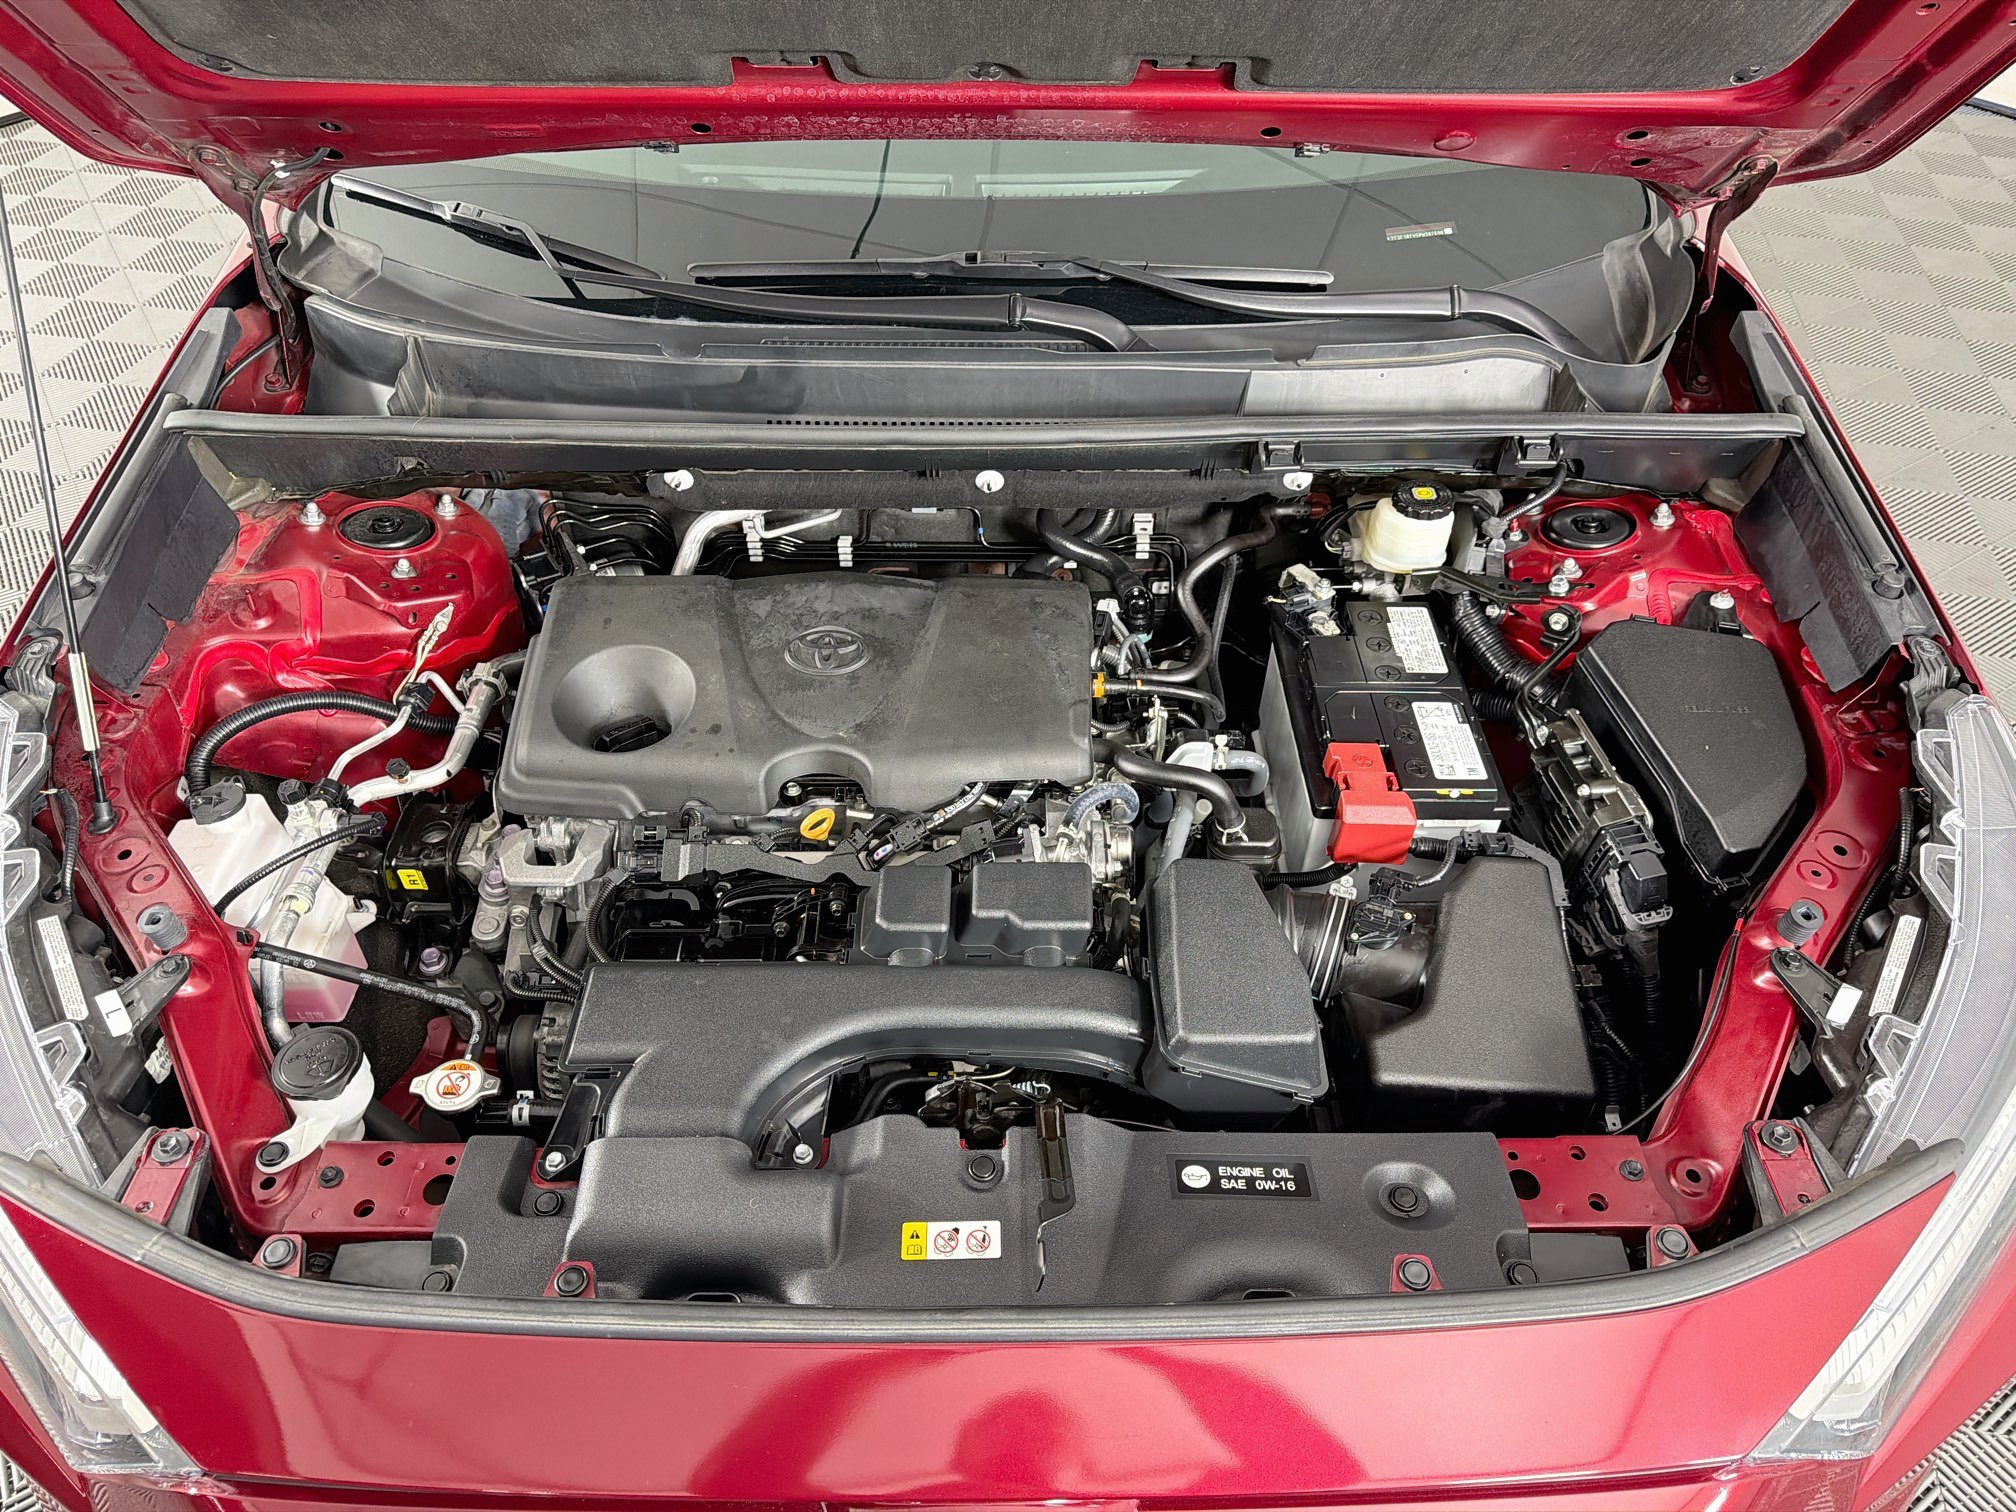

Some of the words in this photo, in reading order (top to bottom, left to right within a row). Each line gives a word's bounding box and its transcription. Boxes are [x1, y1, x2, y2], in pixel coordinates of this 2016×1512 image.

[406, 874, 420, 885] R1
[1218, 1166, 1265, 1178] ENGINE
[1272, 1168, 1294, 1178] OIL
[1220, 1179, 1247, 1189] SAE
[1255, 1180, 1296, 1191] 0W-16
